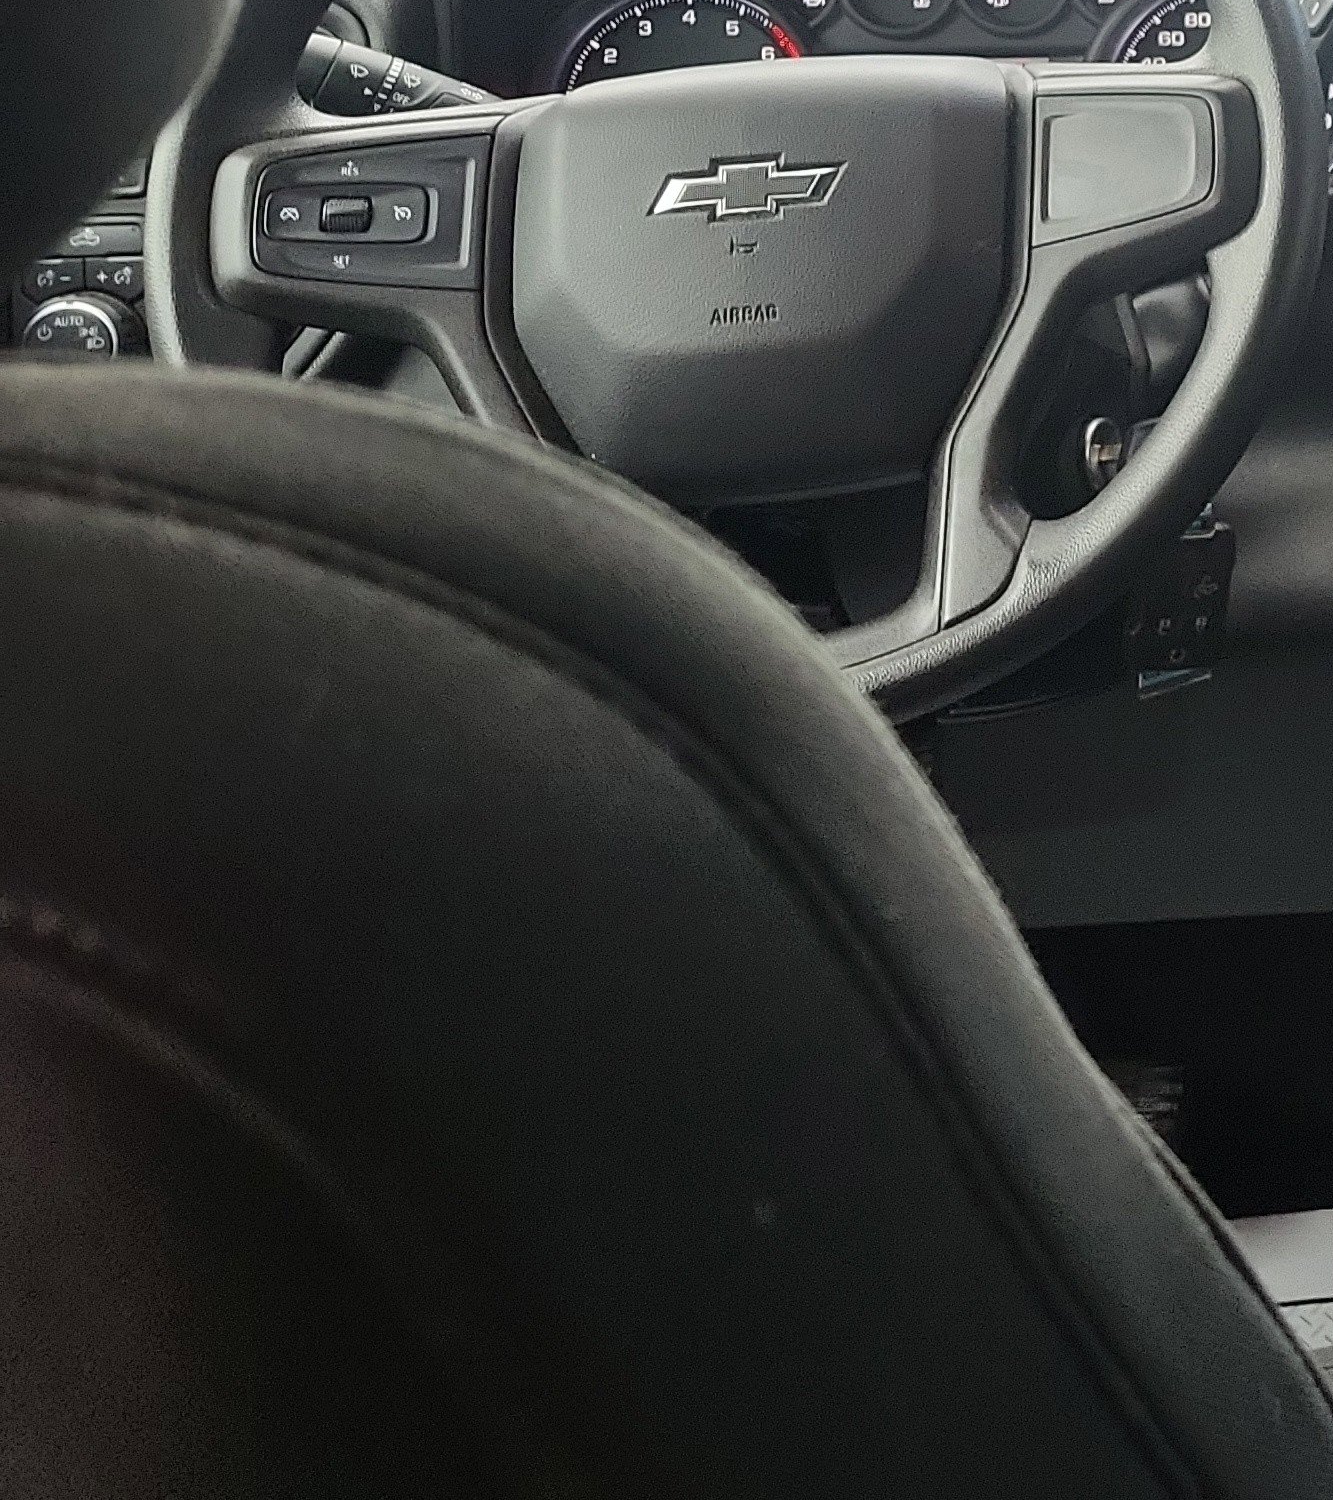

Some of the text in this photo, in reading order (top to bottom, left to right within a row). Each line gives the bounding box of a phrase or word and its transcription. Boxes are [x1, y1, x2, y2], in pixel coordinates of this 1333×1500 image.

[681, 8, 696, 26] 4
[1184, 12, 1212, 29] 80
[638, 20, 652, 37] 3
[725, 19, 740, 36] 5
[1157, 31, 1185, 47] 60
[603, 47, 618, 65] 2
[761, 46, 775, 61] 6
[341, 166, 359, 177] RES
[332, 255, 349, 266] SET
[54, 315, 85, 328] AUTO
[709, 303, 779, 326] AIRBAG
